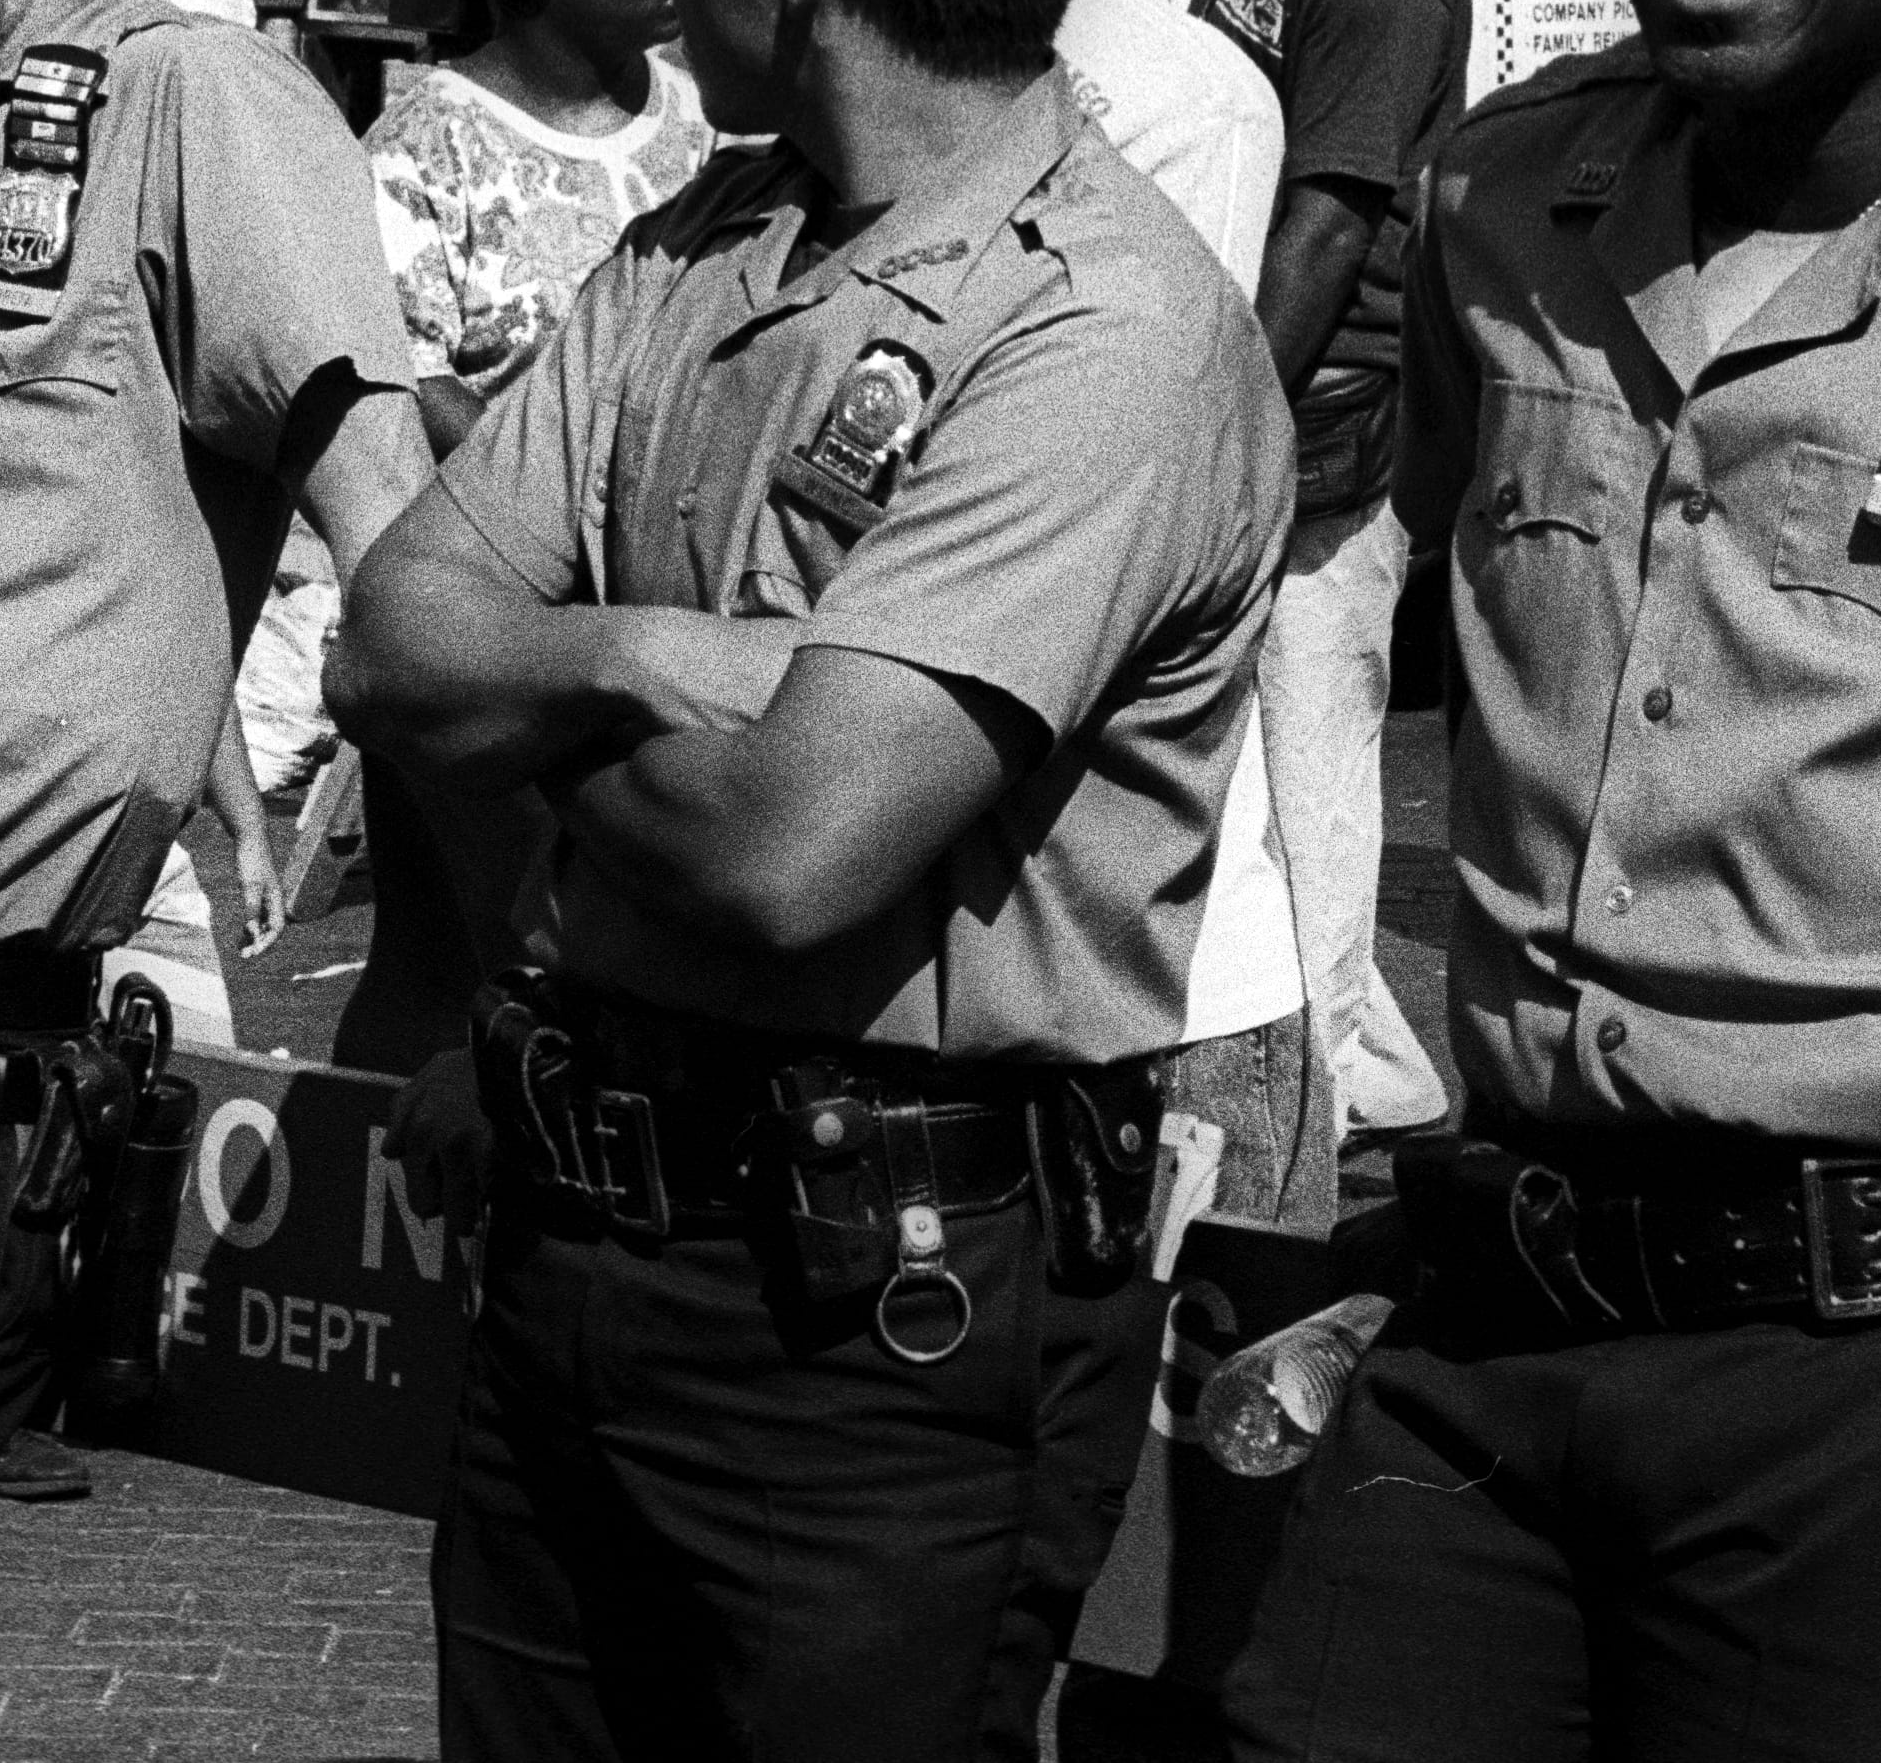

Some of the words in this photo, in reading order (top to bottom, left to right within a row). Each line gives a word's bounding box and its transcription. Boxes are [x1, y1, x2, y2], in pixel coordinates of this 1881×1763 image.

[1532, 0, 1607, 23] COMPANY
[1613, 0, 1636, 21] PIC
[1532, 31, 1586, 54] FAMILY
[198, 1098, 292, 1250] O
[238, 1286, 402, 1388] DEPT.
